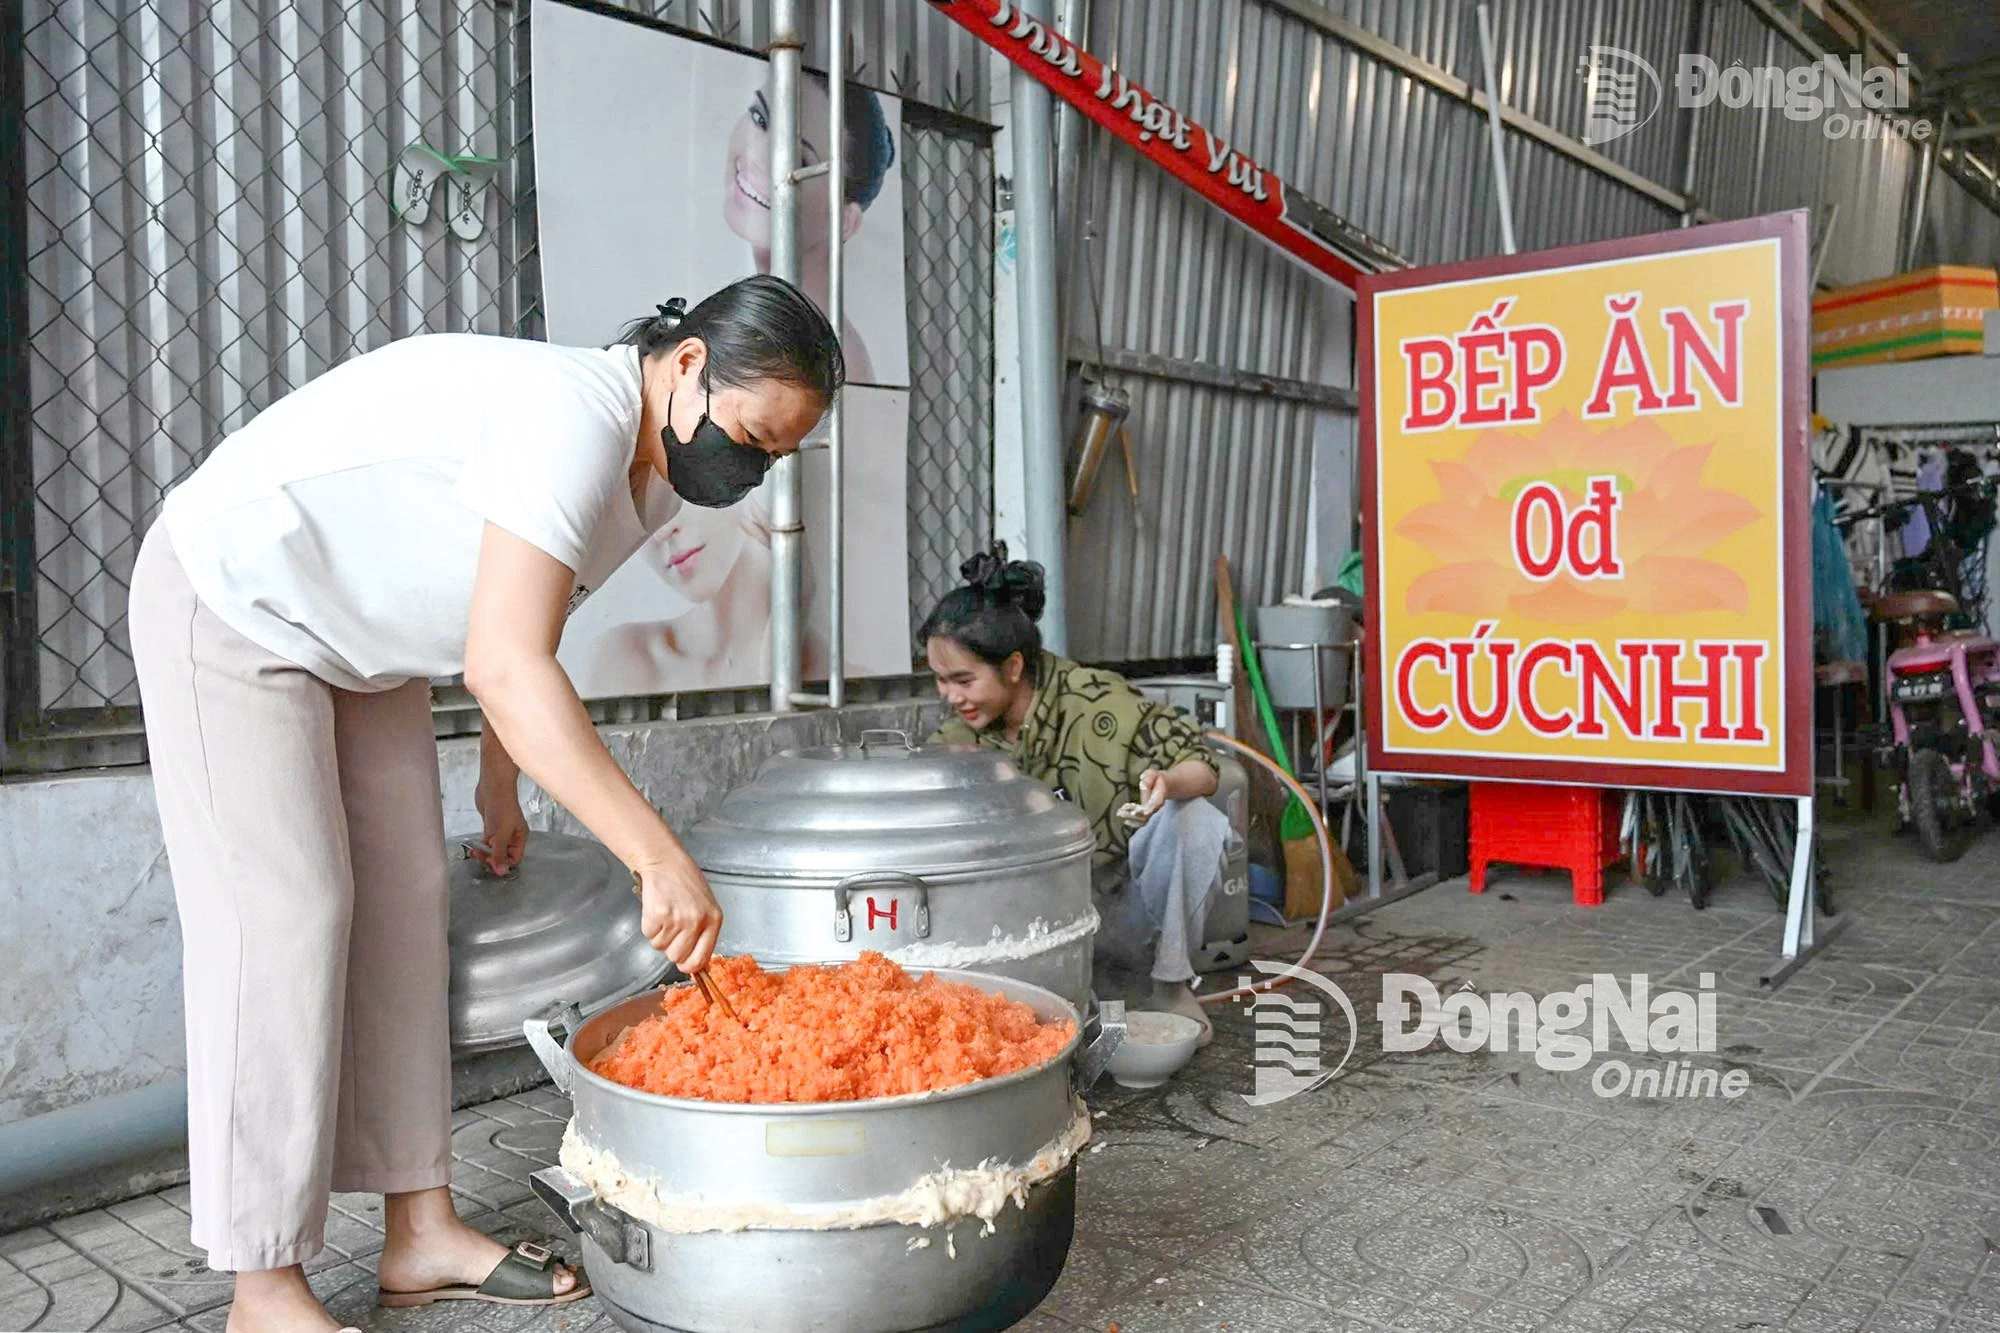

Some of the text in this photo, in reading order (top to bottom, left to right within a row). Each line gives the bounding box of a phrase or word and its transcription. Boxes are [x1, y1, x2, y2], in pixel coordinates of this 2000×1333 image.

[1402, 294, 1748, 432] BẾP ĂN
[1513, 480, 1621, 578] 0đ
[1397, 622, 1765, 742] CÚCNHI
[866, 896, 898, 931] H
